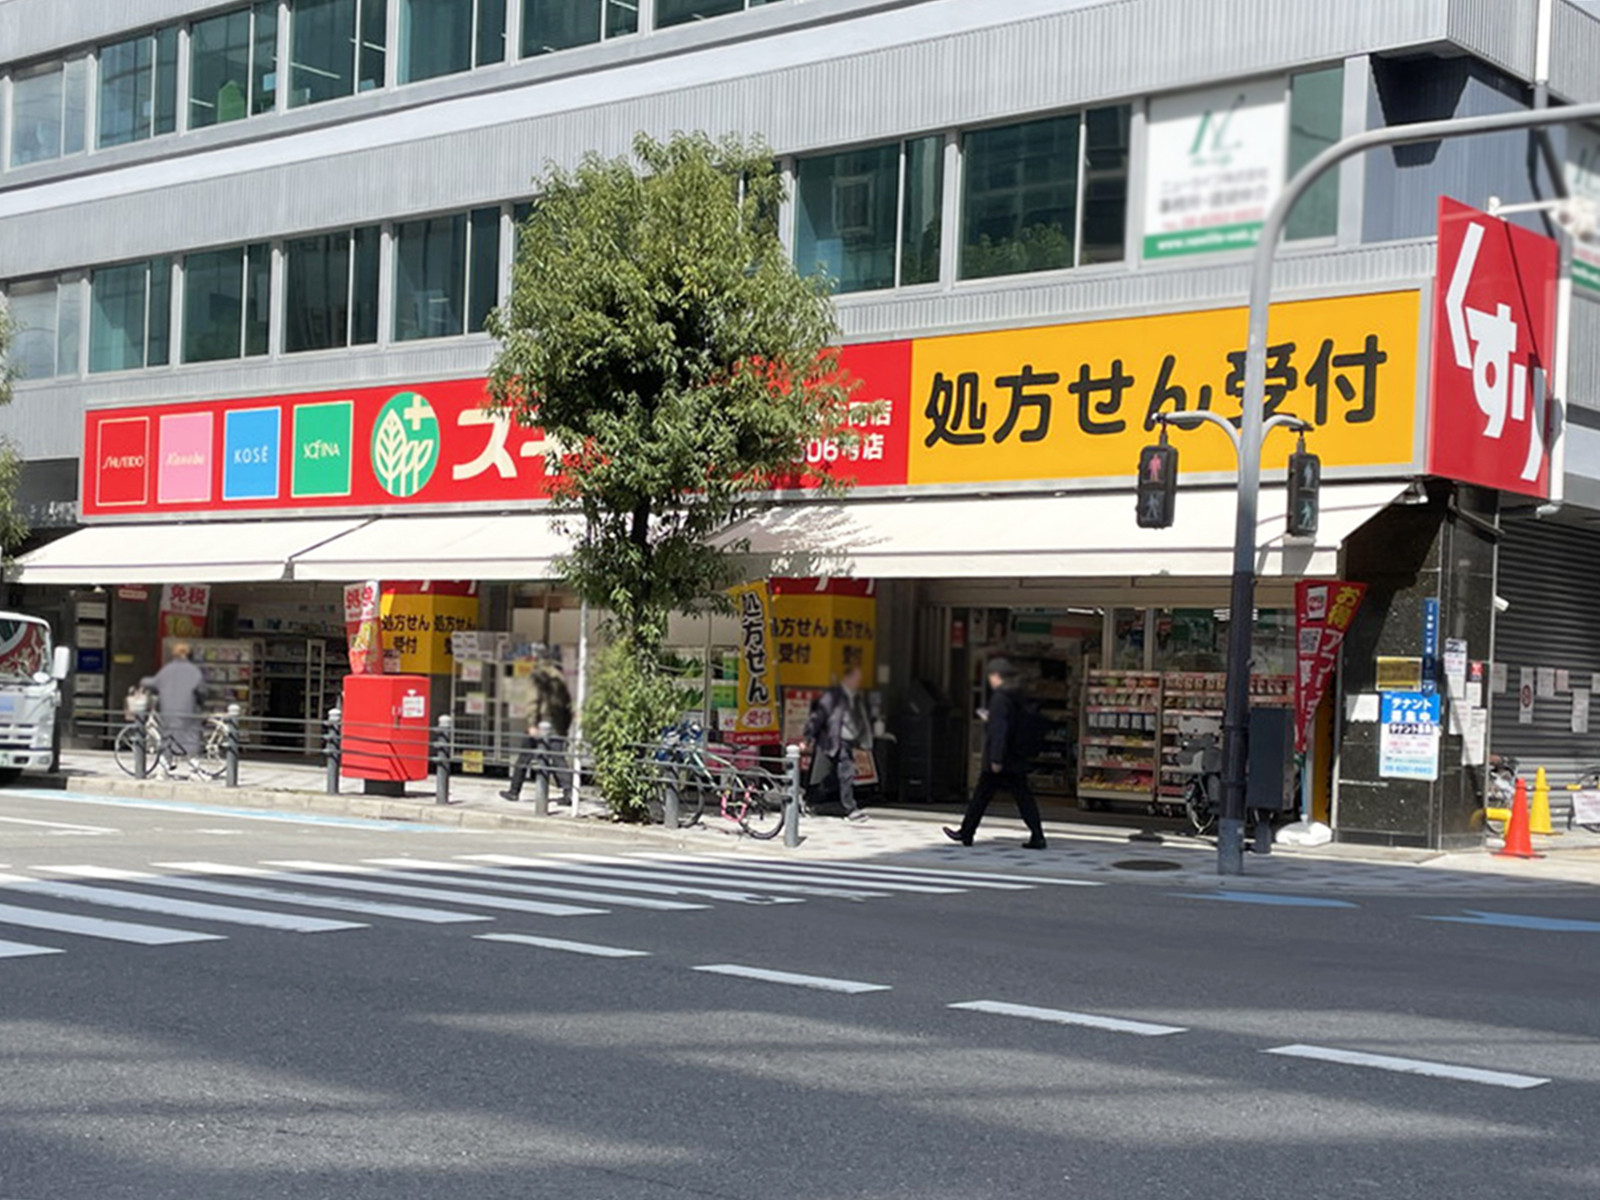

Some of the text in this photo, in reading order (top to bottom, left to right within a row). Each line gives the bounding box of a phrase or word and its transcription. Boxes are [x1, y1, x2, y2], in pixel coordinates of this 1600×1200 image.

[1446, 221, 1546, 482] くすり
[924, 334, 1387, 447] 処方せん受付
[393, 635, 417, 655] 受付
[741, 592, 769, 704] 処方せん
[778, 642, 811, 664] 受付
[1391, 698, 1432, 711] テナント
